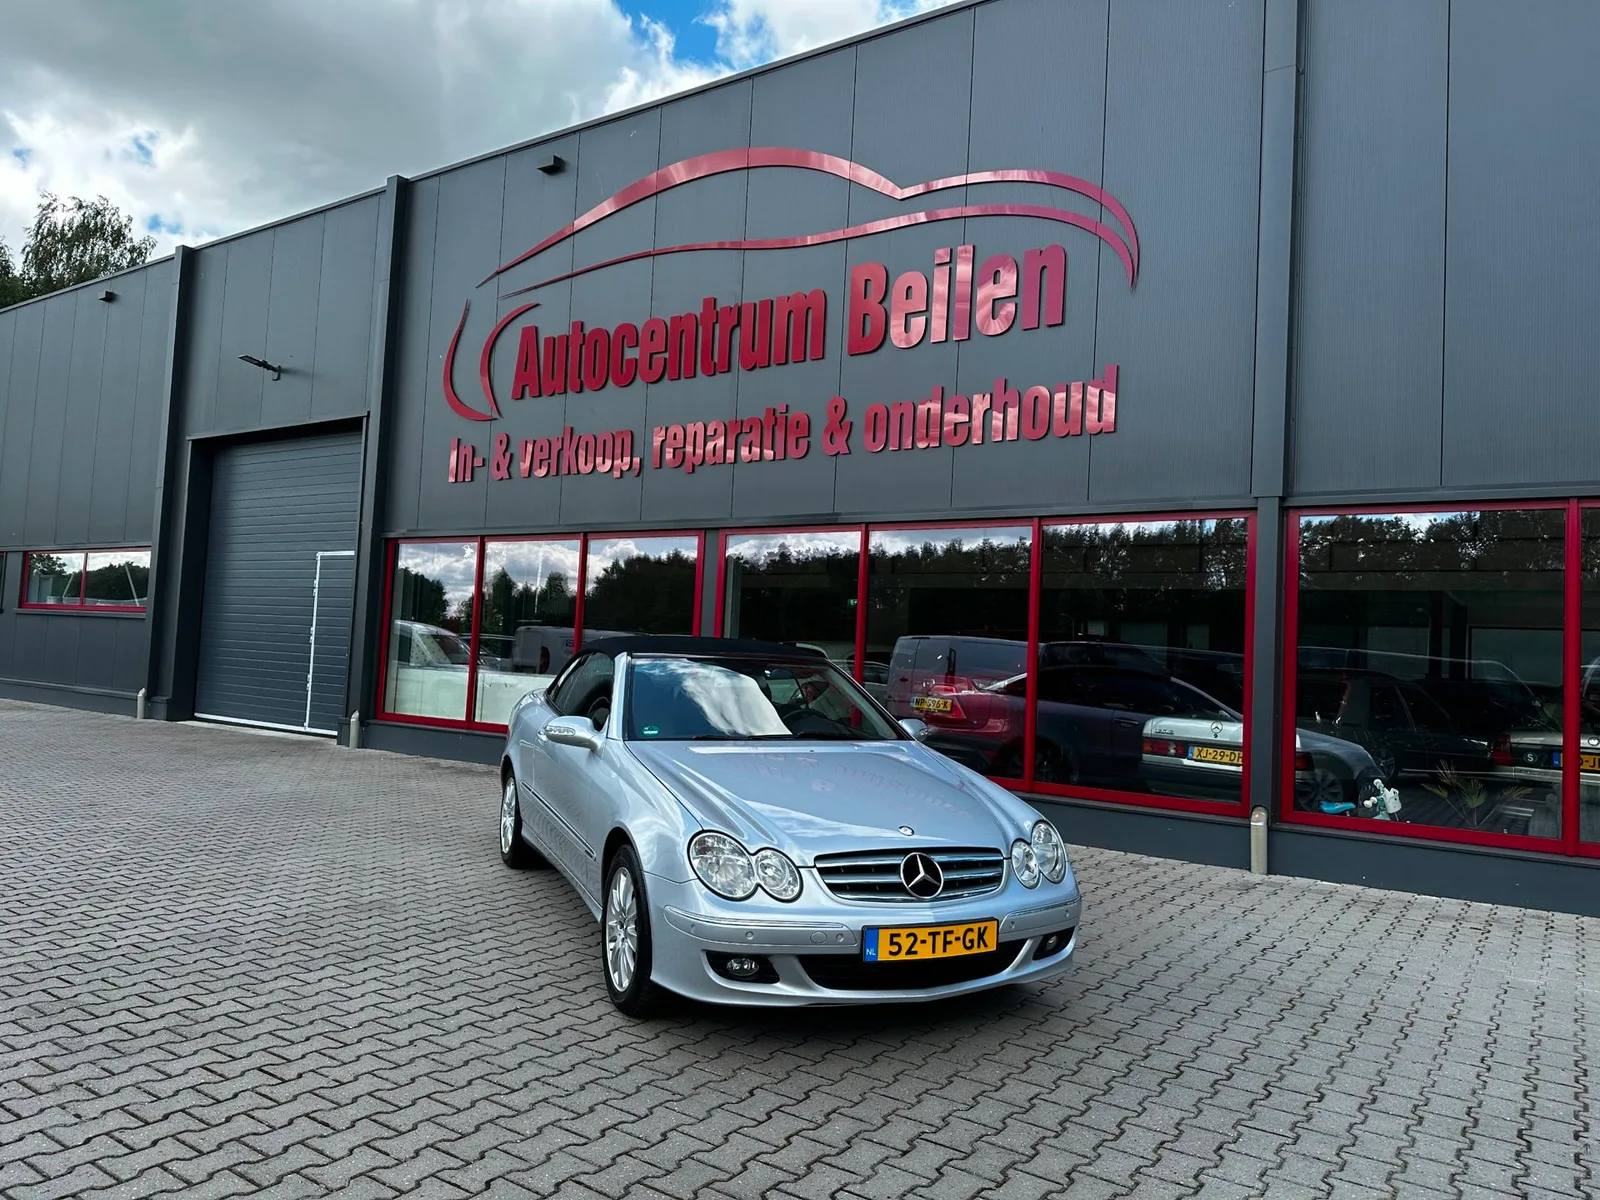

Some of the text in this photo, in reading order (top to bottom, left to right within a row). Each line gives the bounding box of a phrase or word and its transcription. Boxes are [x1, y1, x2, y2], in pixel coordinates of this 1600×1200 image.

[510, 243, 1067, 400] Autocentrum Beilen
[448, 363, 1119, 484] In- & verkoop, reparatie & onderhoud
[866, 925, 989, 957] NL 52-TF-GK
